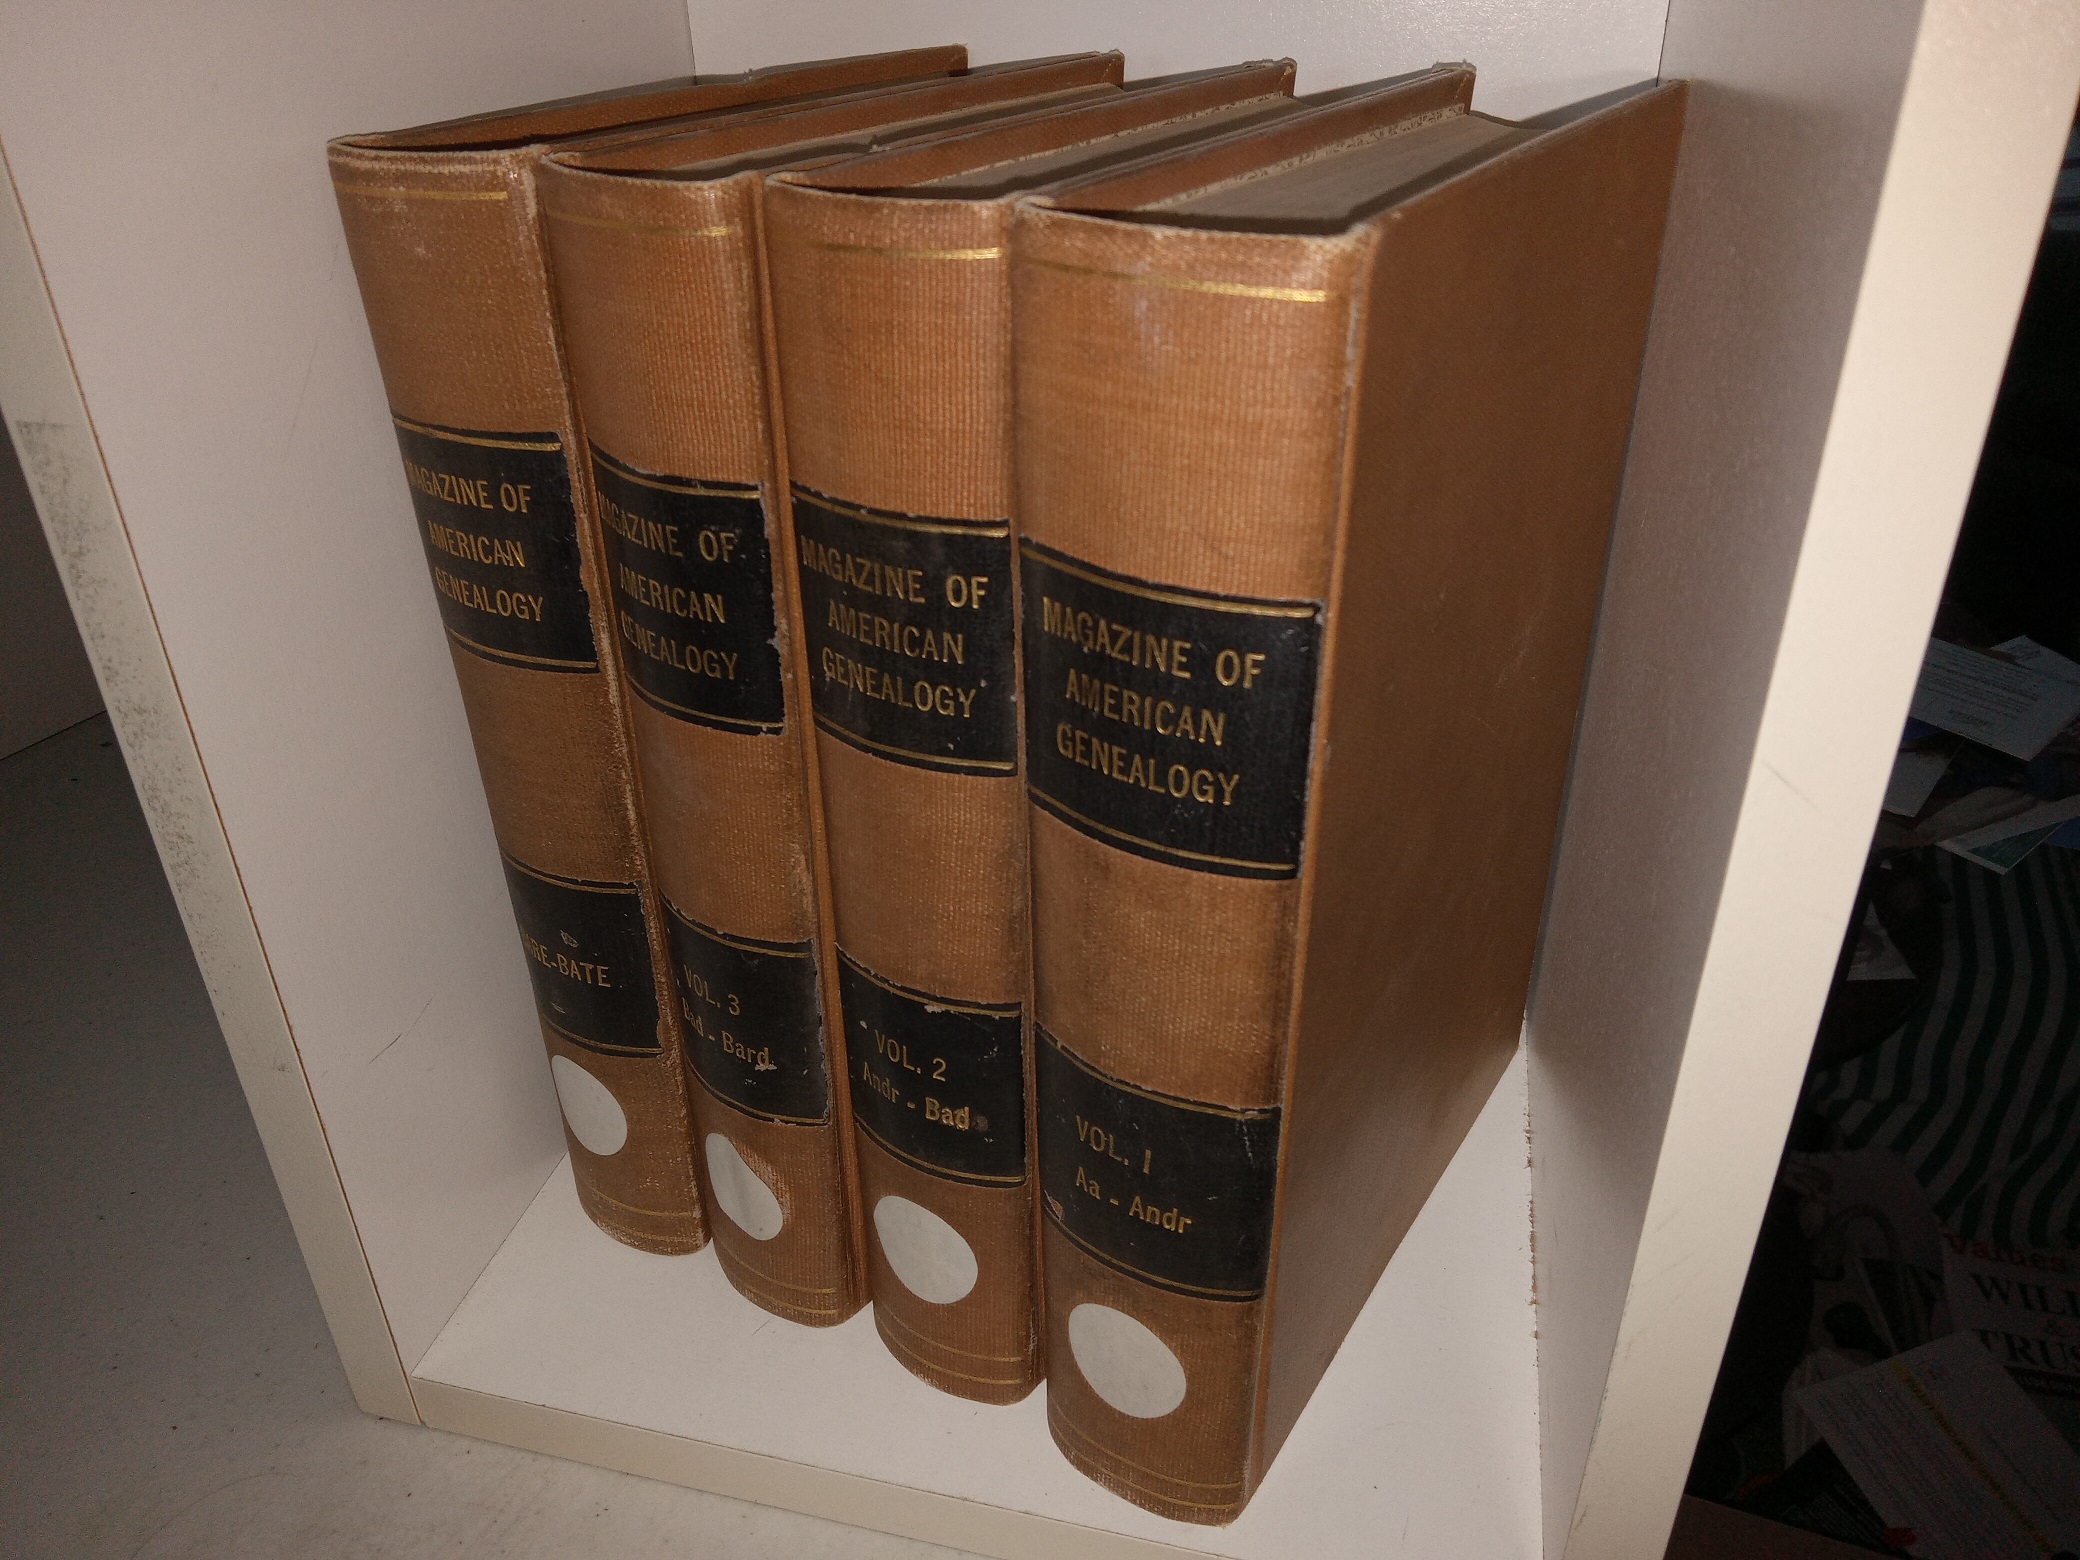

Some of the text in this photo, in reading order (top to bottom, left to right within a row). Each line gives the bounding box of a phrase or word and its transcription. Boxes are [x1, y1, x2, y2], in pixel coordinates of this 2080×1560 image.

[499, 482, 532, 514] OF
[426, 519, 527, 569] AMERICAN
[699, 529, 736, 563] OF
[799, 534, 989, 610] MAGAZINE OF
[434, 566, 545, 623] GENEALOGY
[618, 562, 727, 624] AMERICAN
[619, 609, 738, 681] GENEALOGY
[826, 598, 966, 666] AMERICAN
[1041, 595, 1267, 690] MAGAZINE OF
[821, 646, 978, 720] GENEALOGY
[1064, 667, 1227, 747] AMERICAN
[1055, 722, 1241, 808] GENEALOGY
[682, 964, 741, 1017] VOL. 3
[721, 1030, 771, 1068] Bard
[874, 1028, 948, 1082] VOL. 2
[862, 1061, 901, 1105] Andr
[924, 1096, 971, 1131] Bad
[1075, 1114, 1131, 1166] VOL.
[1075, 1166, 1101, 1200] Aa
[1128, 1195, 1192, 1235] Andr
